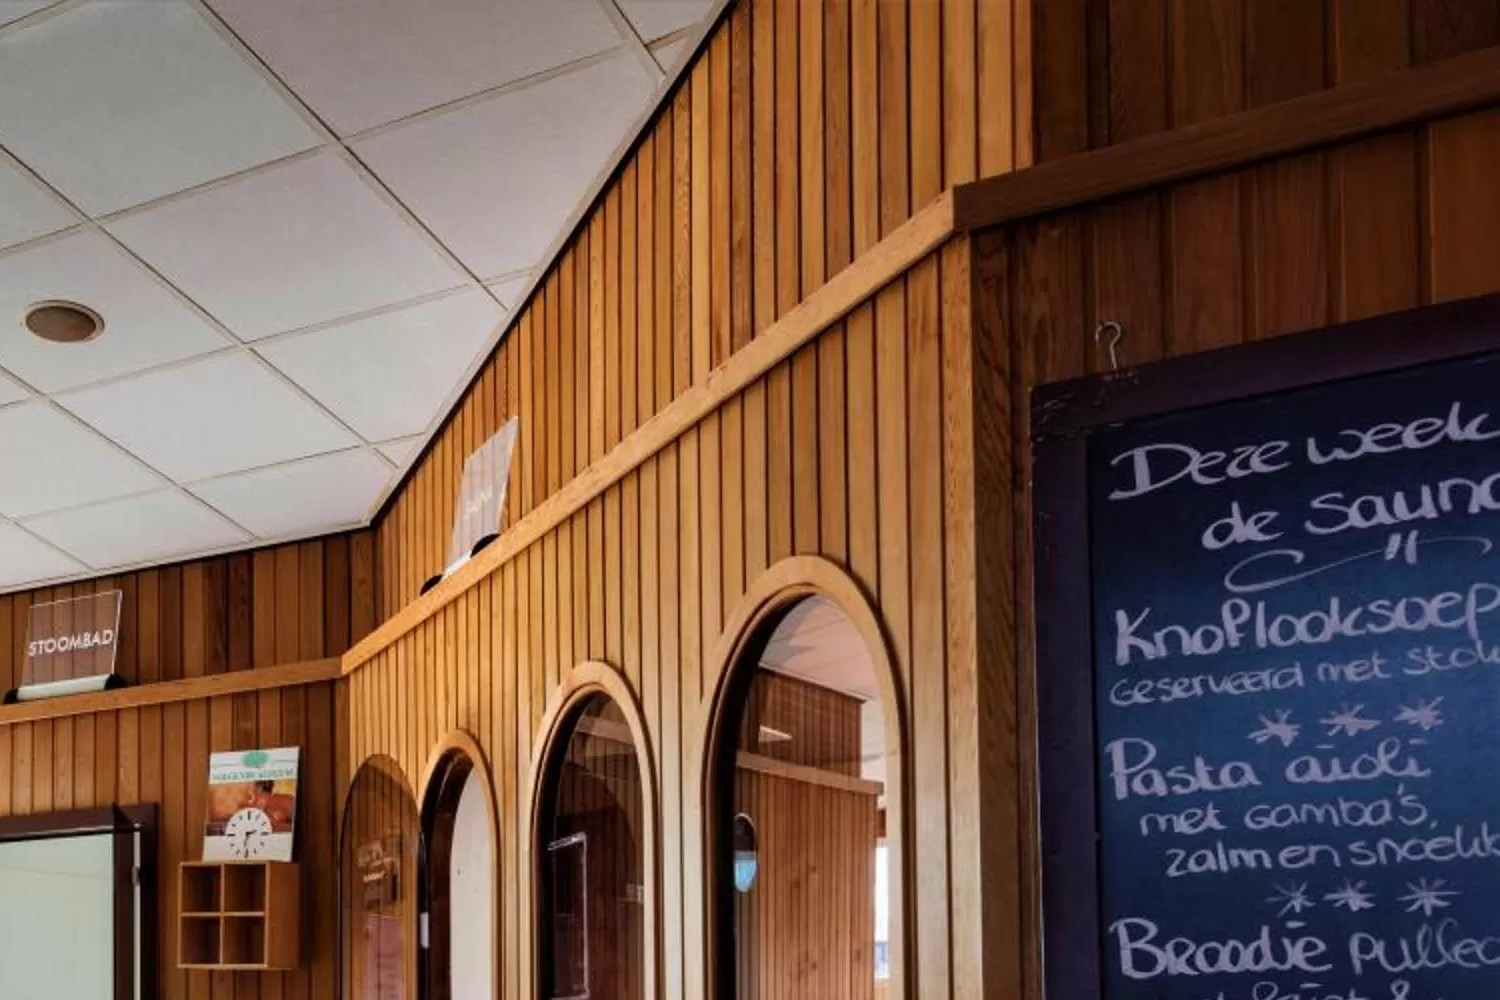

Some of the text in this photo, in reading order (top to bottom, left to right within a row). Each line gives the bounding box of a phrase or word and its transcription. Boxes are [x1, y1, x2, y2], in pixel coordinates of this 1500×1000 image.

[1108, 402, 1500, 501] Deze week
[1202, 501, 1284, 549] de
[28, 629, 113, 656] STOOMBAD
[1317, 651, 1392, 683] met
[1105, 737, 1261, 800] Pasta
[1139, 802, 1228, 836] met
[1165, 840, 1272, 877] zalm
[1279, 844, 1341, 870] en
